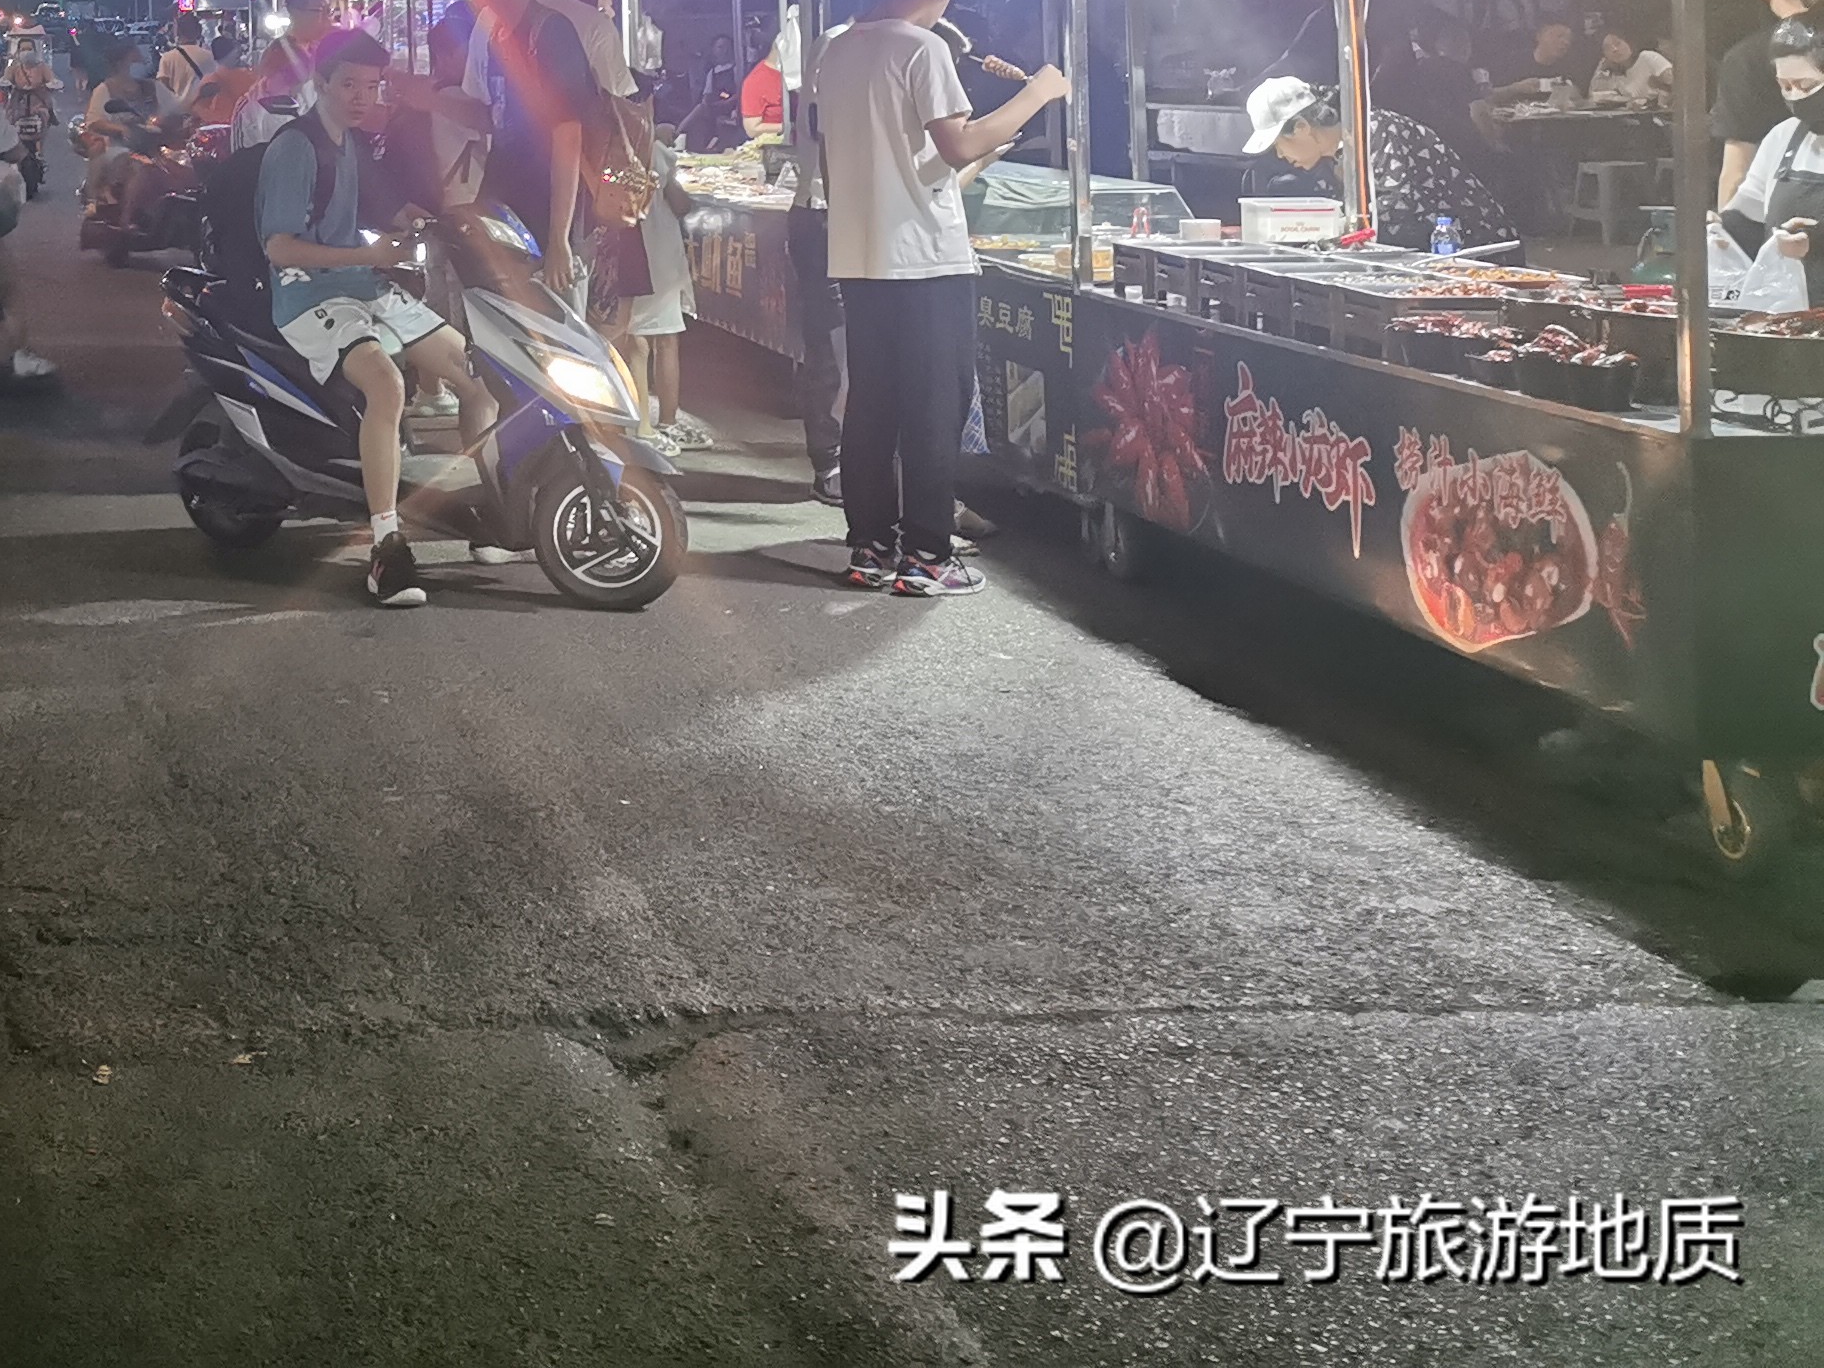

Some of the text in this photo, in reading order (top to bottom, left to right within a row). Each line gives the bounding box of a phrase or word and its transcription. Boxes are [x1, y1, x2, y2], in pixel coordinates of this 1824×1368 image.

[977, 295, 1035, 341] 臭豆腐
[1224, 361, 1376, 560] 麻辣小龙虾
